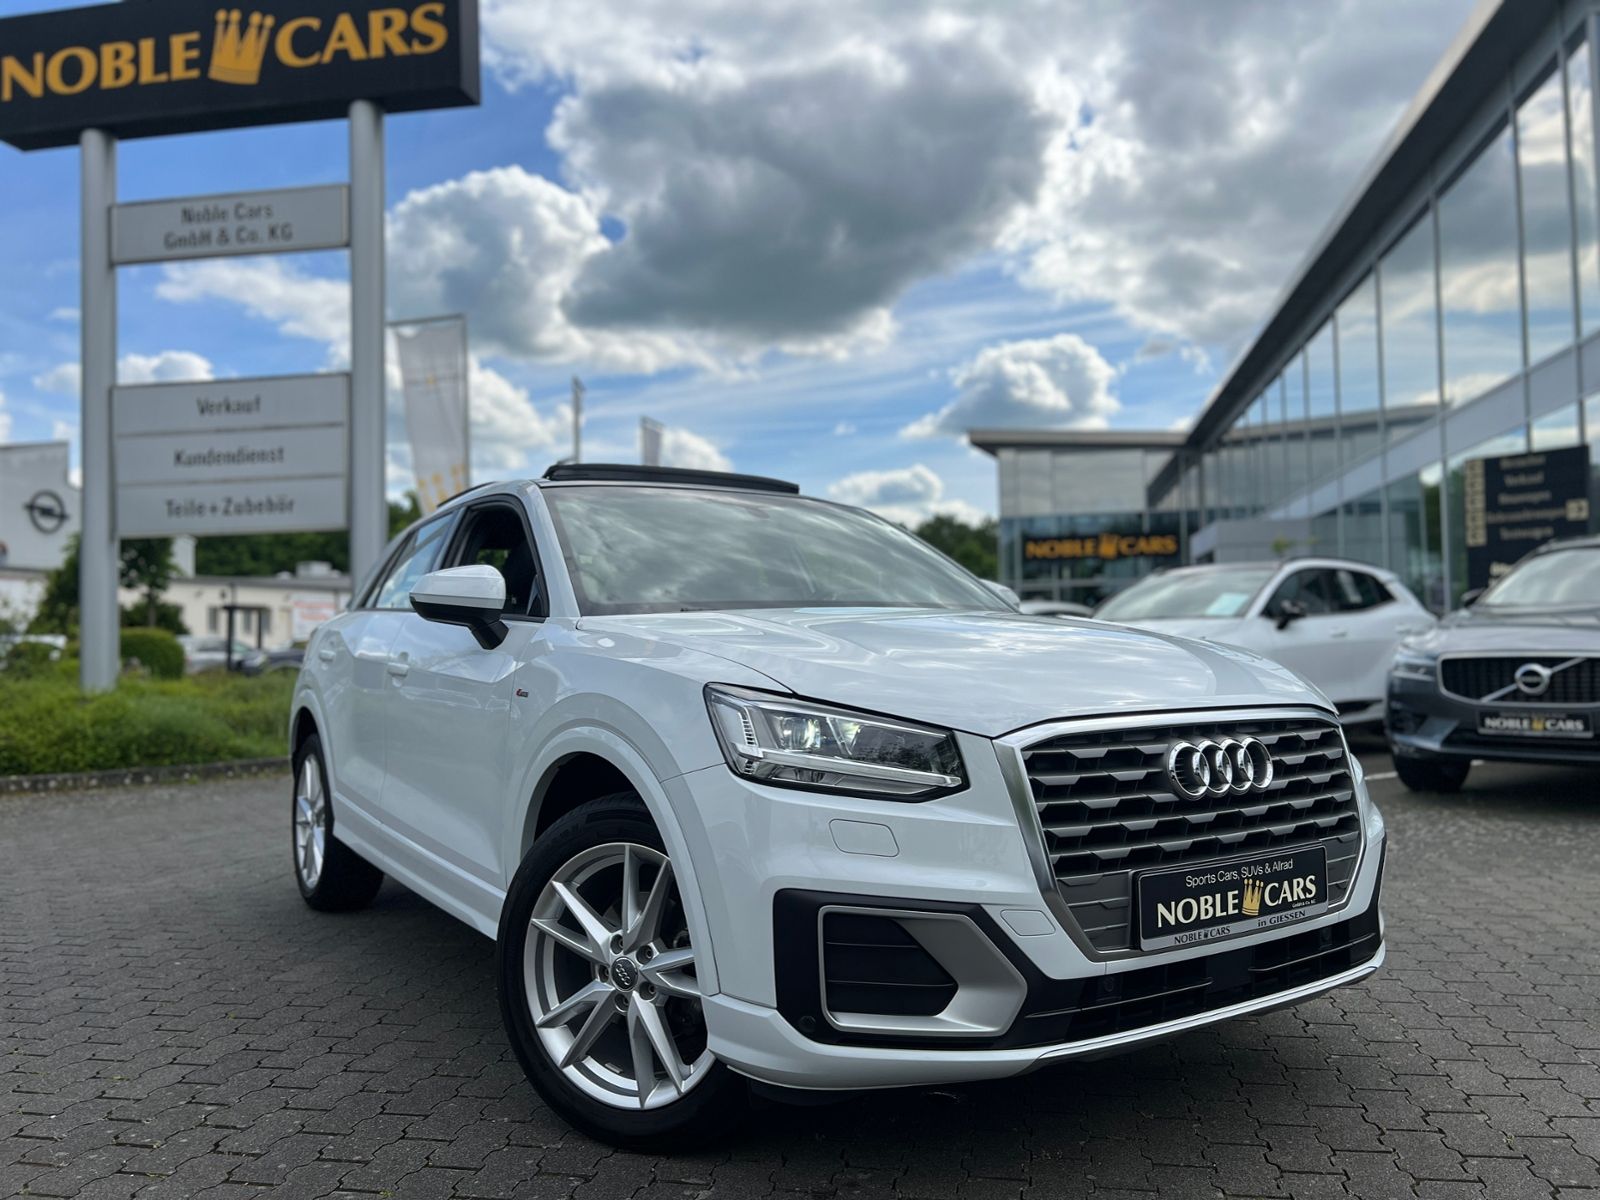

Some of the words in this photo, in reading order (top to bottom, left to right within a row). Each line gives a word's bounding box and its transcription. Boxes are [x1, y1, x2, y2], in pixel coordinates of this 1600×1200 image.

[0, 31, 200, 101] NOBLE
[275, 3, 447, 67] CARS
[181, 205, 228, 223] Noble
[234, 202, 273, 219] Cars
[163, 230, 212, 250] GmbH
[216, 226, 230, 246] &
[268, 222, 293, 242] KG
[196, 394, 261, 416] Verkauf
[173, 446, 284, 467] Kundendienst
[1025, 539, 1096, 558] NOBLE
[1119, 535, 1177, 555] CARS
[1484, 717, 1530, 729] NOBLE
[1545, 718, 1584, 731] CARS
[1185, 873, 1216, 888] Sports
[1217, 869, 1240, 882] Cars,
[1241, 864, 1263, 878] SUVs
[1264, 862, 1271, 874] &
[1272, 858, 1294, 872] Allrad
[1157, 890, 1239, 928] NOBLE
[1264, 875, 1316, 907] CARS
[1174, 933, 1202, 945] NOBLE
[1209, 926, 1231, 938] CARS
[1257, 919, 1267, 927] in
[1269, 910, 1306, 925] GIESSEN
